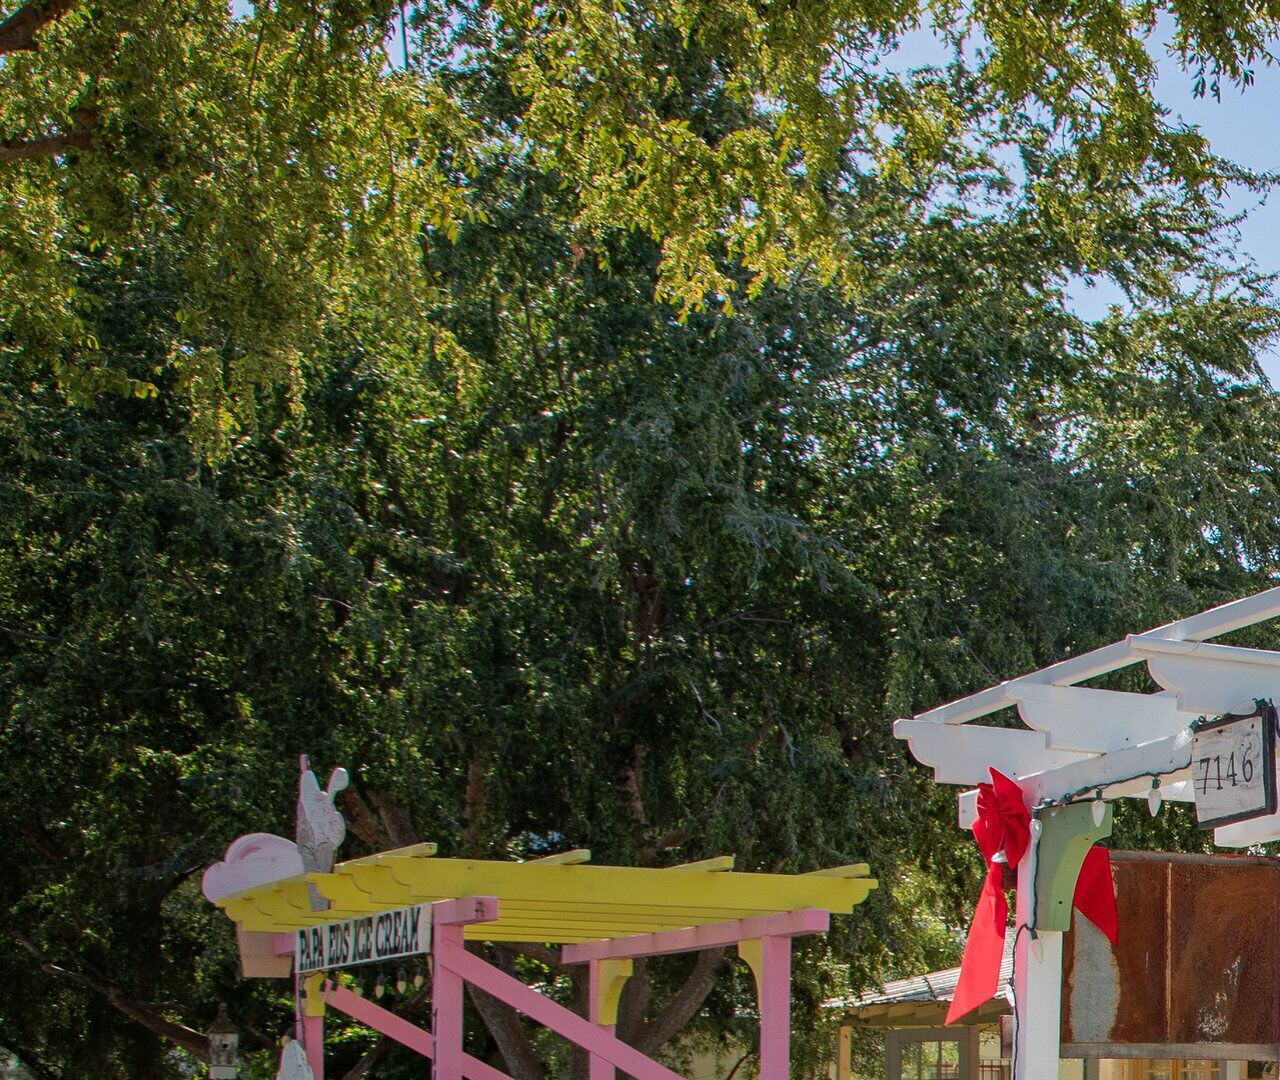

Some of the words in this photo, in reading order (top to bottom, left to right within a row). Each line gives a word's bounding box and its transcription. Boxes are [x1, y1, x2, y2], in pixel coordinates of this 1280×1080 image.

[1200, 742, 1253, 795] 7146
[300, 926, 325, 971] PAPA
[351, 915, 373, 963] ICE
[375, 906, 422, 958] CREAM
